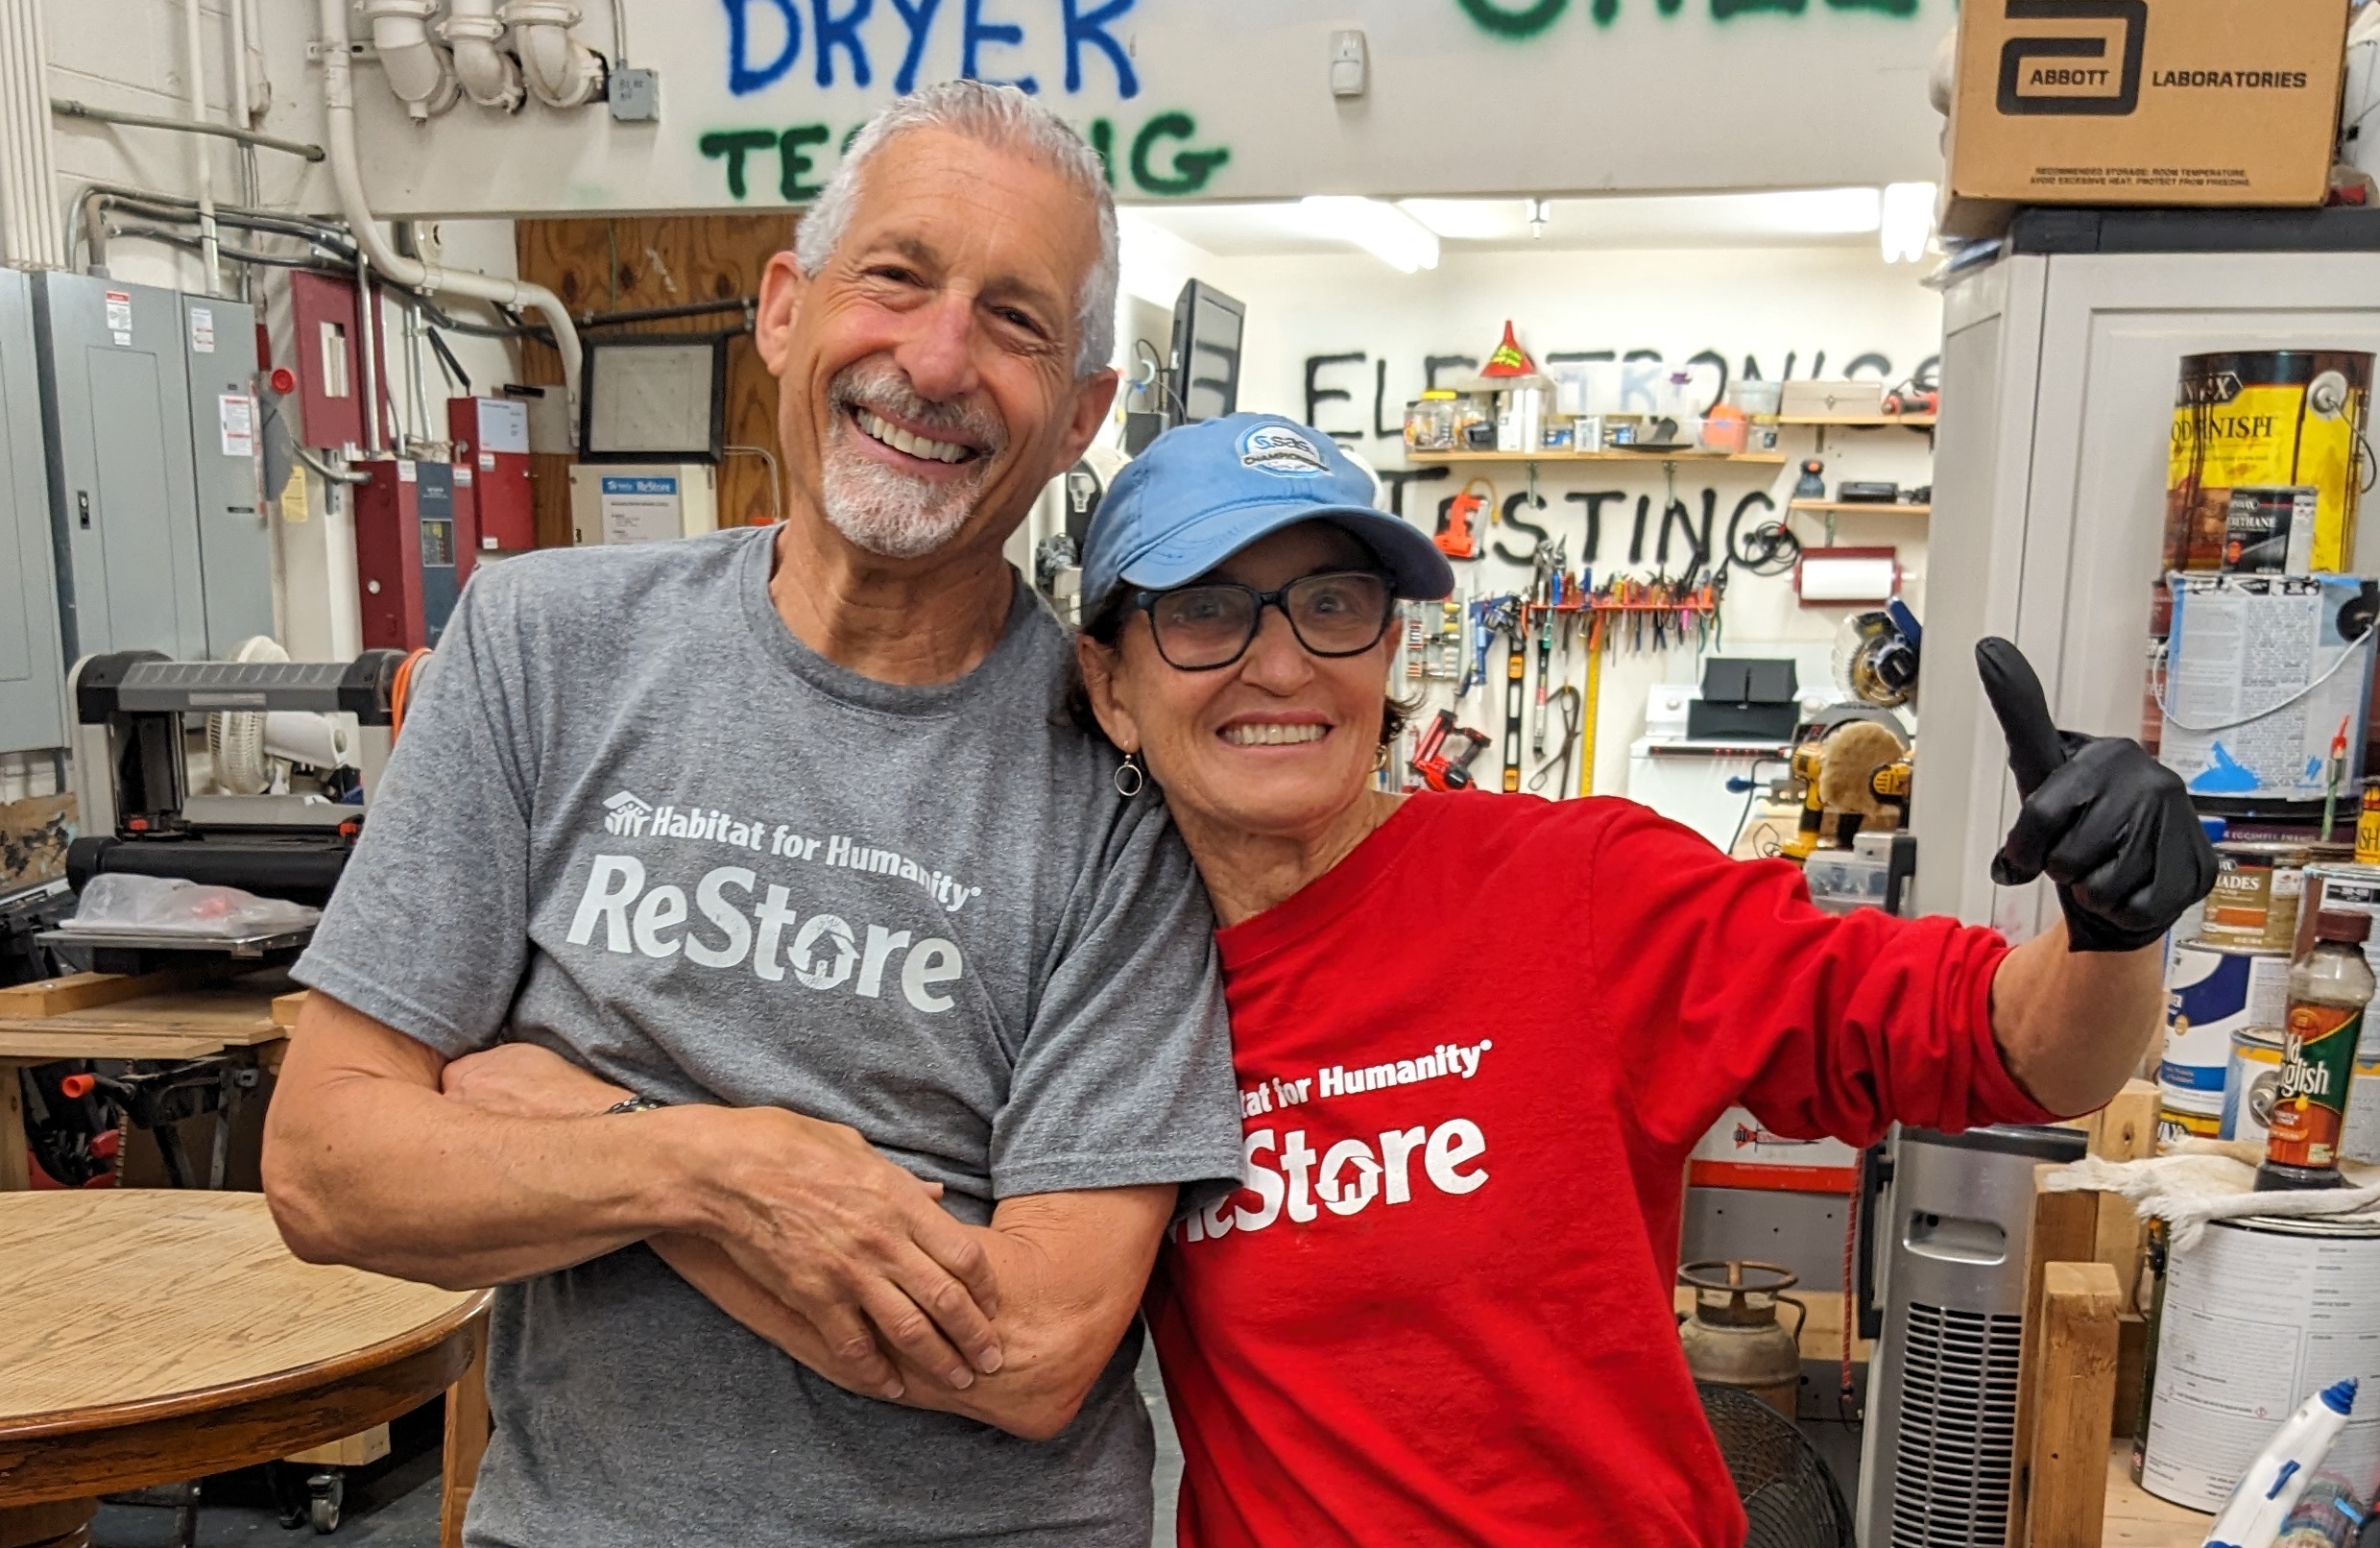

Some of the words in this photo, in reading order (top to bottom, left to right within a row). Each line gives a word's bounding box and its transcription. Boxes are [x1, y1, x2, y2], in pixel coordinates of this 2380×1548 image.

[721, 0, 1140, 98] DRYER
[2030, 69, 2109, 86] ABBOTT
[2152, 70, 2307, 88] LABORATORIES
[650, 807, 765, 851] Habitat
[770, 825, 821, 861] for
[566, 854, 963, 1013] ReStore
[1272, 1076, 1312, 1108] for
